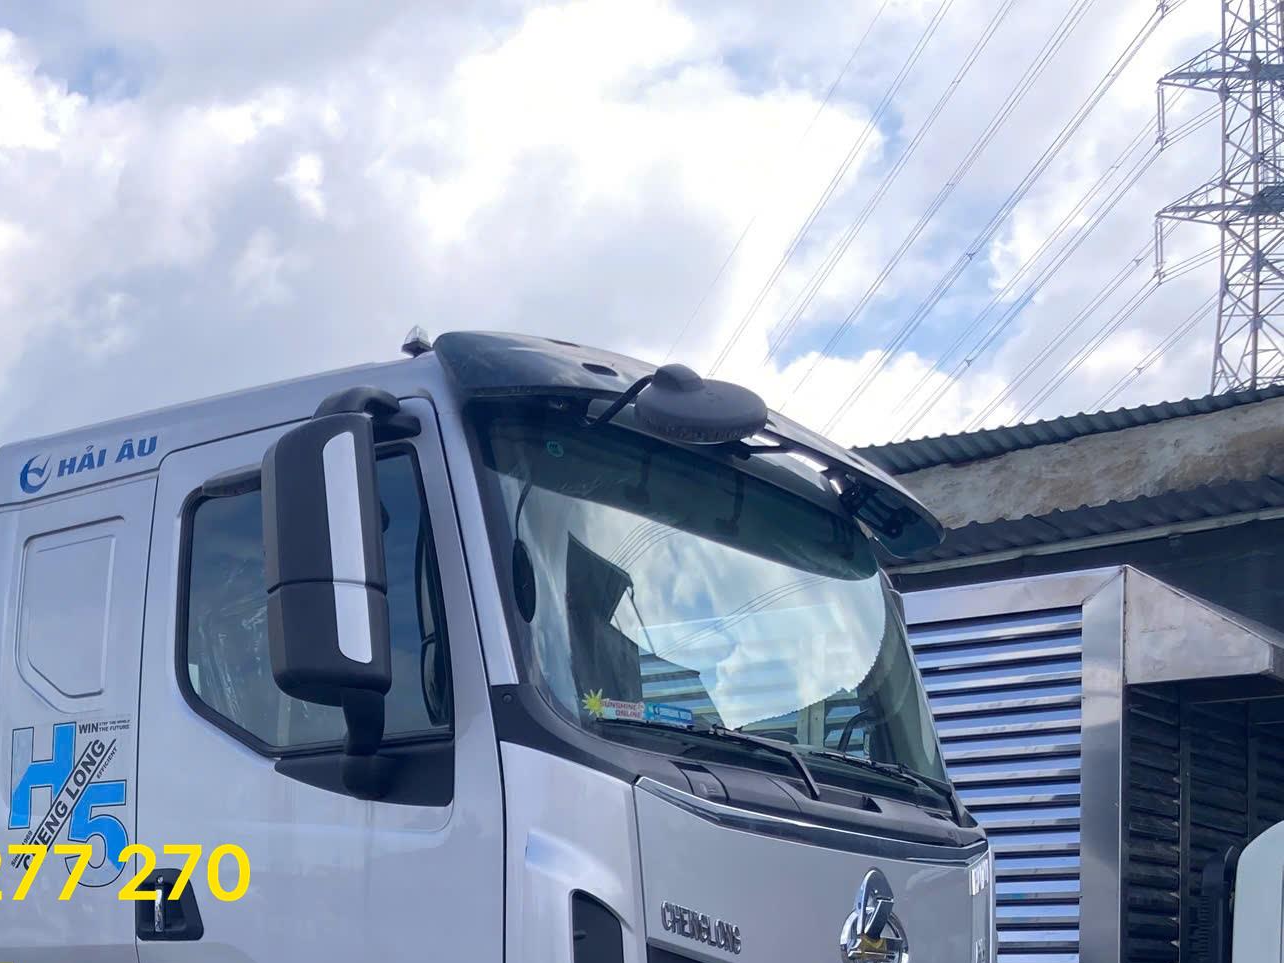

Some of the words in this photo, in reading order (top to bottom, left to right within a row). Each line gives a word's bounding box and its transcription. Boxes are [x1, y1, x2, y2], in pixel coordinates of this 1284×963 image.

[57, 445, 107, 477] HẢI
[115, 436, 158, 463] ÂU
[78, 722, 99, 734] WIN
[65, 739, 106, 800] LONG
[660, 900, 741, 955] CHENGLONG
